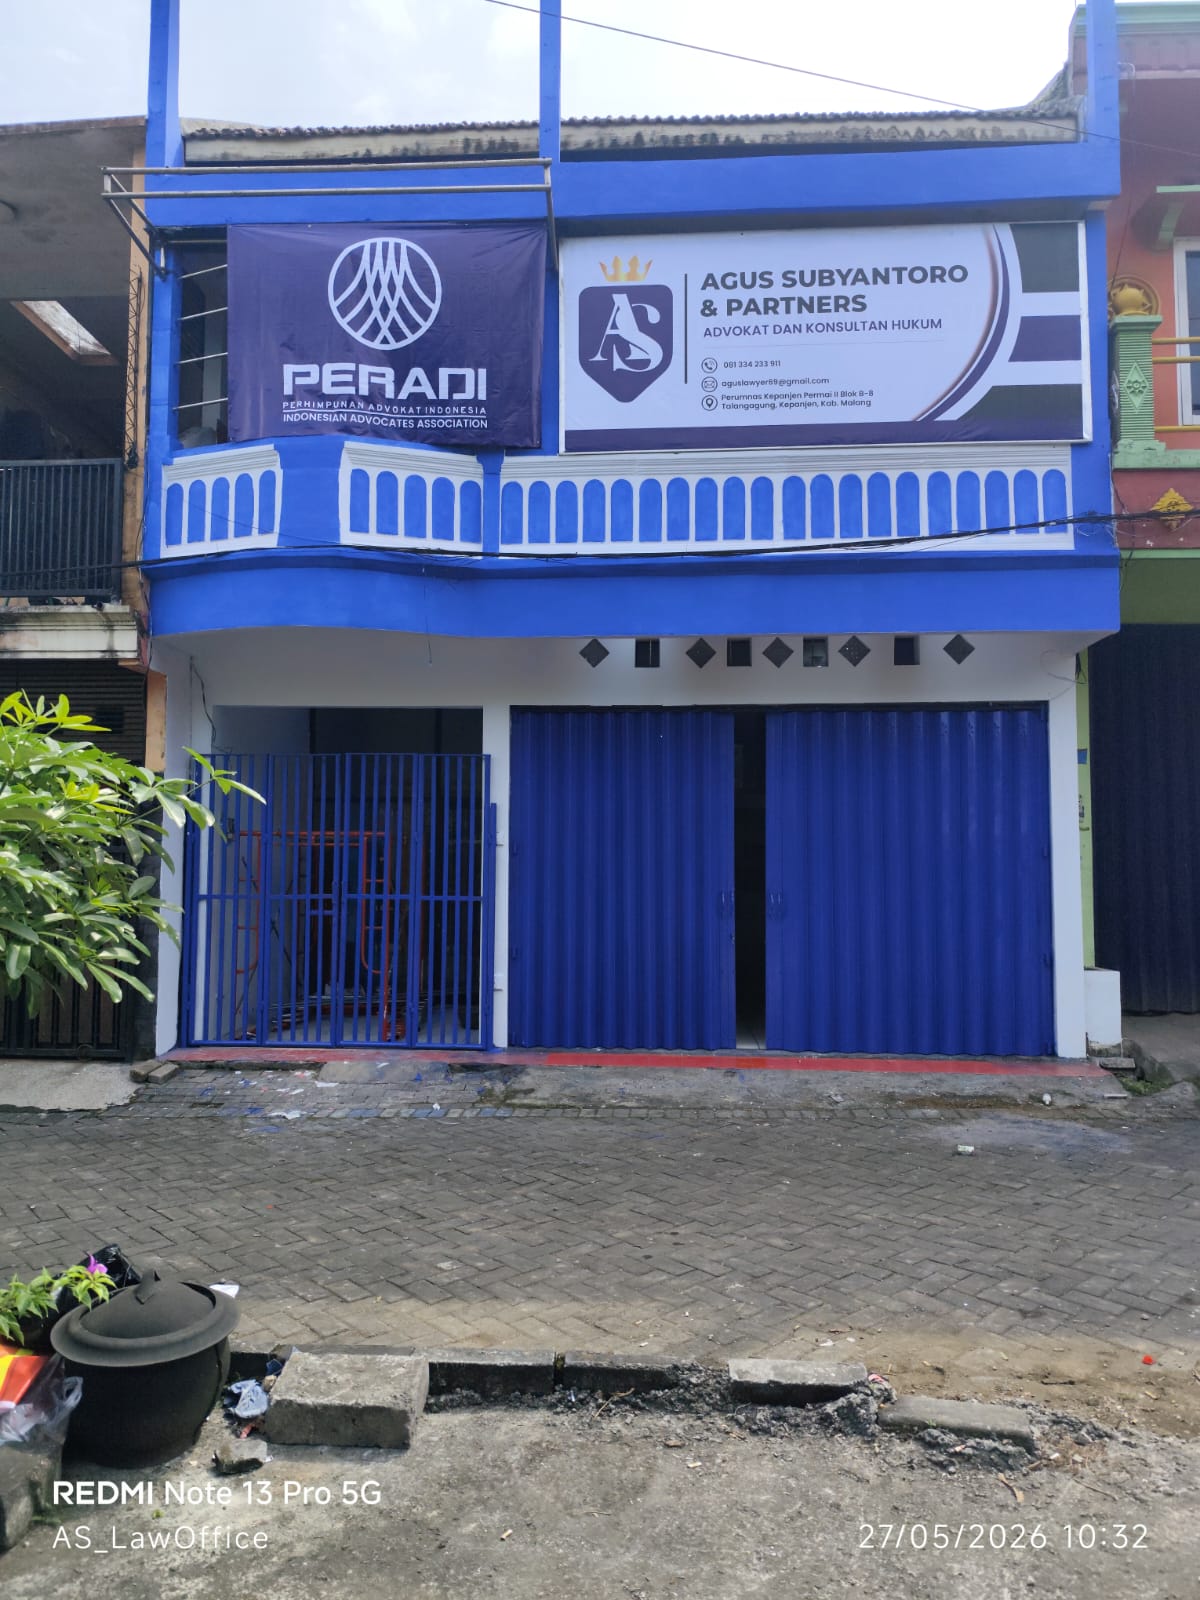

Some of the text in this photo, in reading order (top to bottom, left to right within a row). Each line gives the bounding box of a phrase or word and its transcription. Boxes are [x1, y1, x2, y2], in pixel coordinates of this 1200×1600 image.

[701, 264, 968, 291] AGUS SUBYANTORO
[700, 294, 867, 318] & PARTNERS
[703, 318, 942, 338] ADVOKAT DAN KONSULTAN HUKUM
[283, 363, 487, 401] PERADI
[721, 393, 763, 401] Perumnas
[764, 391, 802, 401] Kepanjen
[803, 390, 832, 399] Permai
[840, 390, 857, 398] Blok
[840, 399, 872, 408] Malang
[282, 401, 487, 414] PERHIMPUNAN ADVOKAT INDONESIA
[283, 413, 488, 429] INDONESIAN ADVOCATES ASSOCIATION
